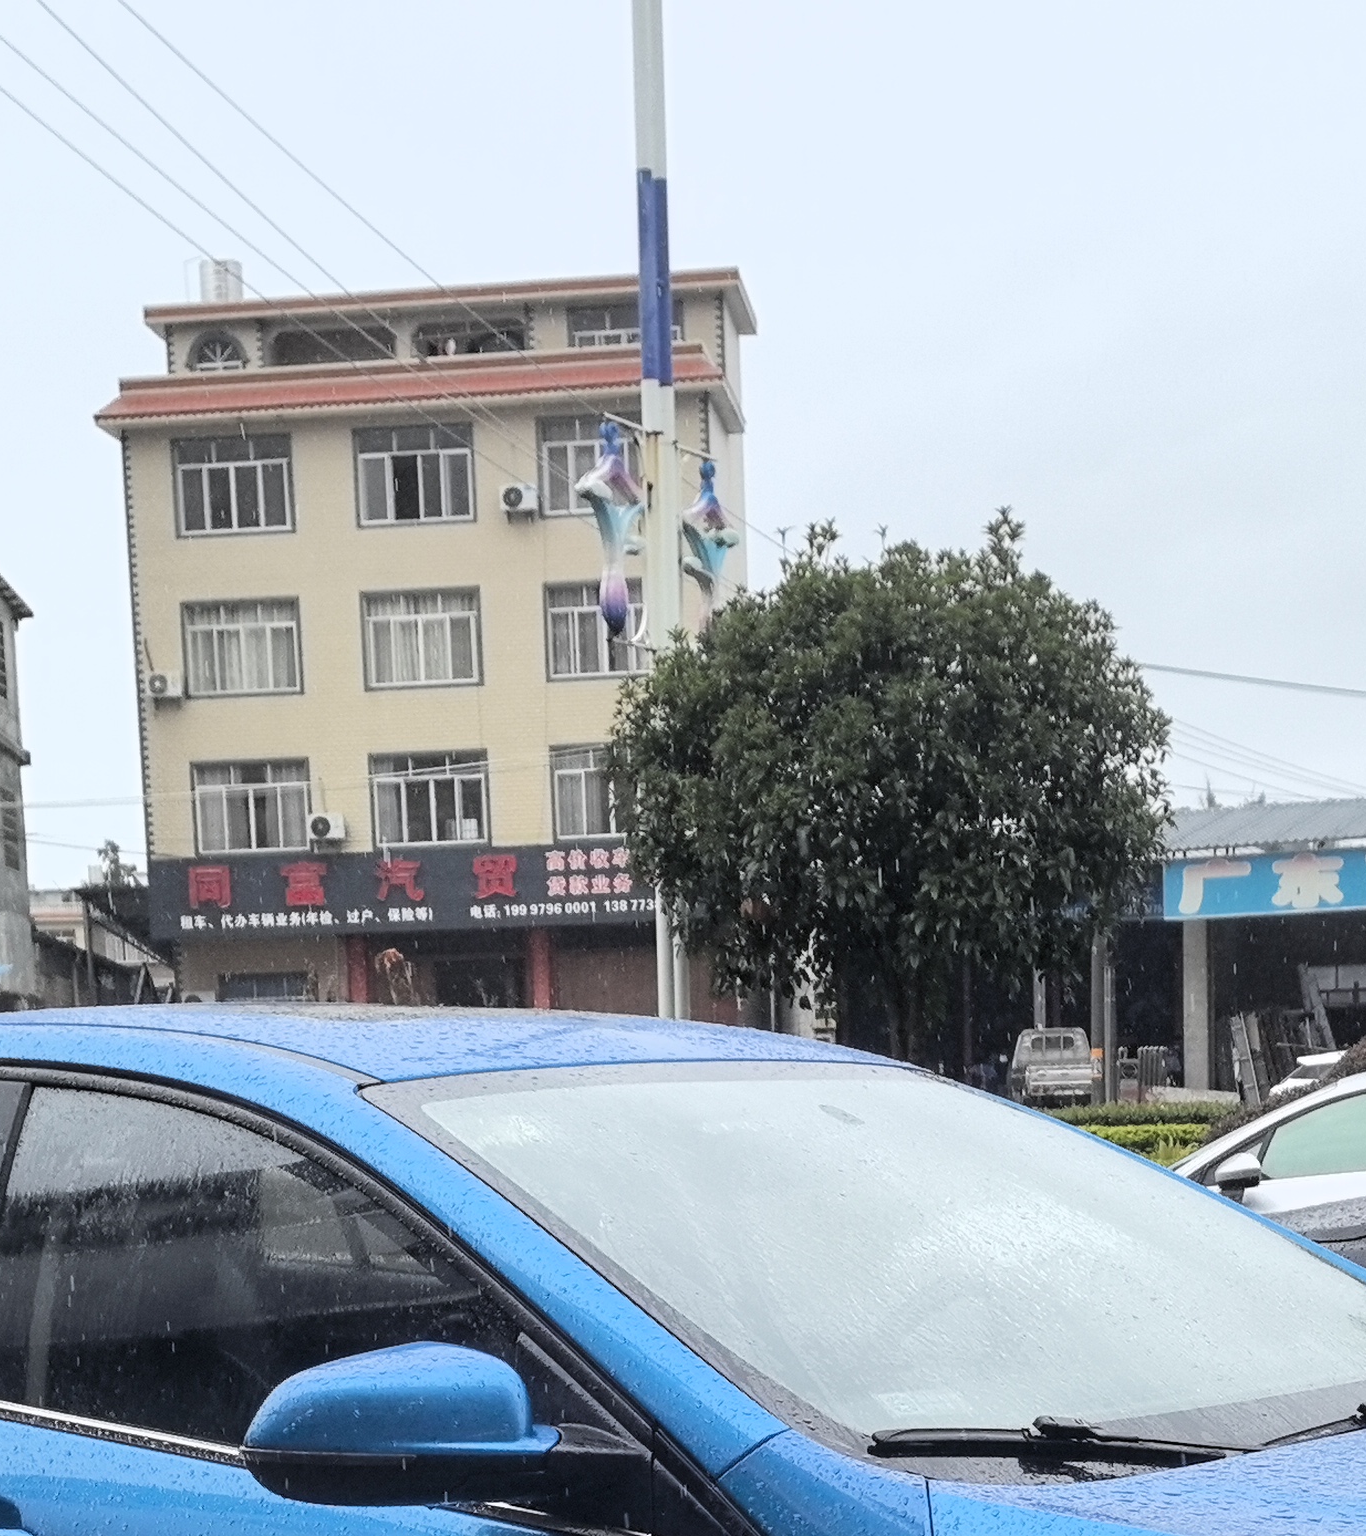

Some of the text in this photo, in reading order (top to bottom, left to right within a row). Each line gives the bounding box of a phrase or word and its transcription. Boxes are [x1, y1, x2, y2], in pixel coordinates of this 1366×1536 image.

[188, 854, 517, 909] 同富汽贸
[546, 872, 633, 897] 贷款业务
[504, 904, 527, 918] 199
[530, 902, 563, 917] 9796
[565, 901, 597, 915] 0001
[603, 899, 628, 913] 138
